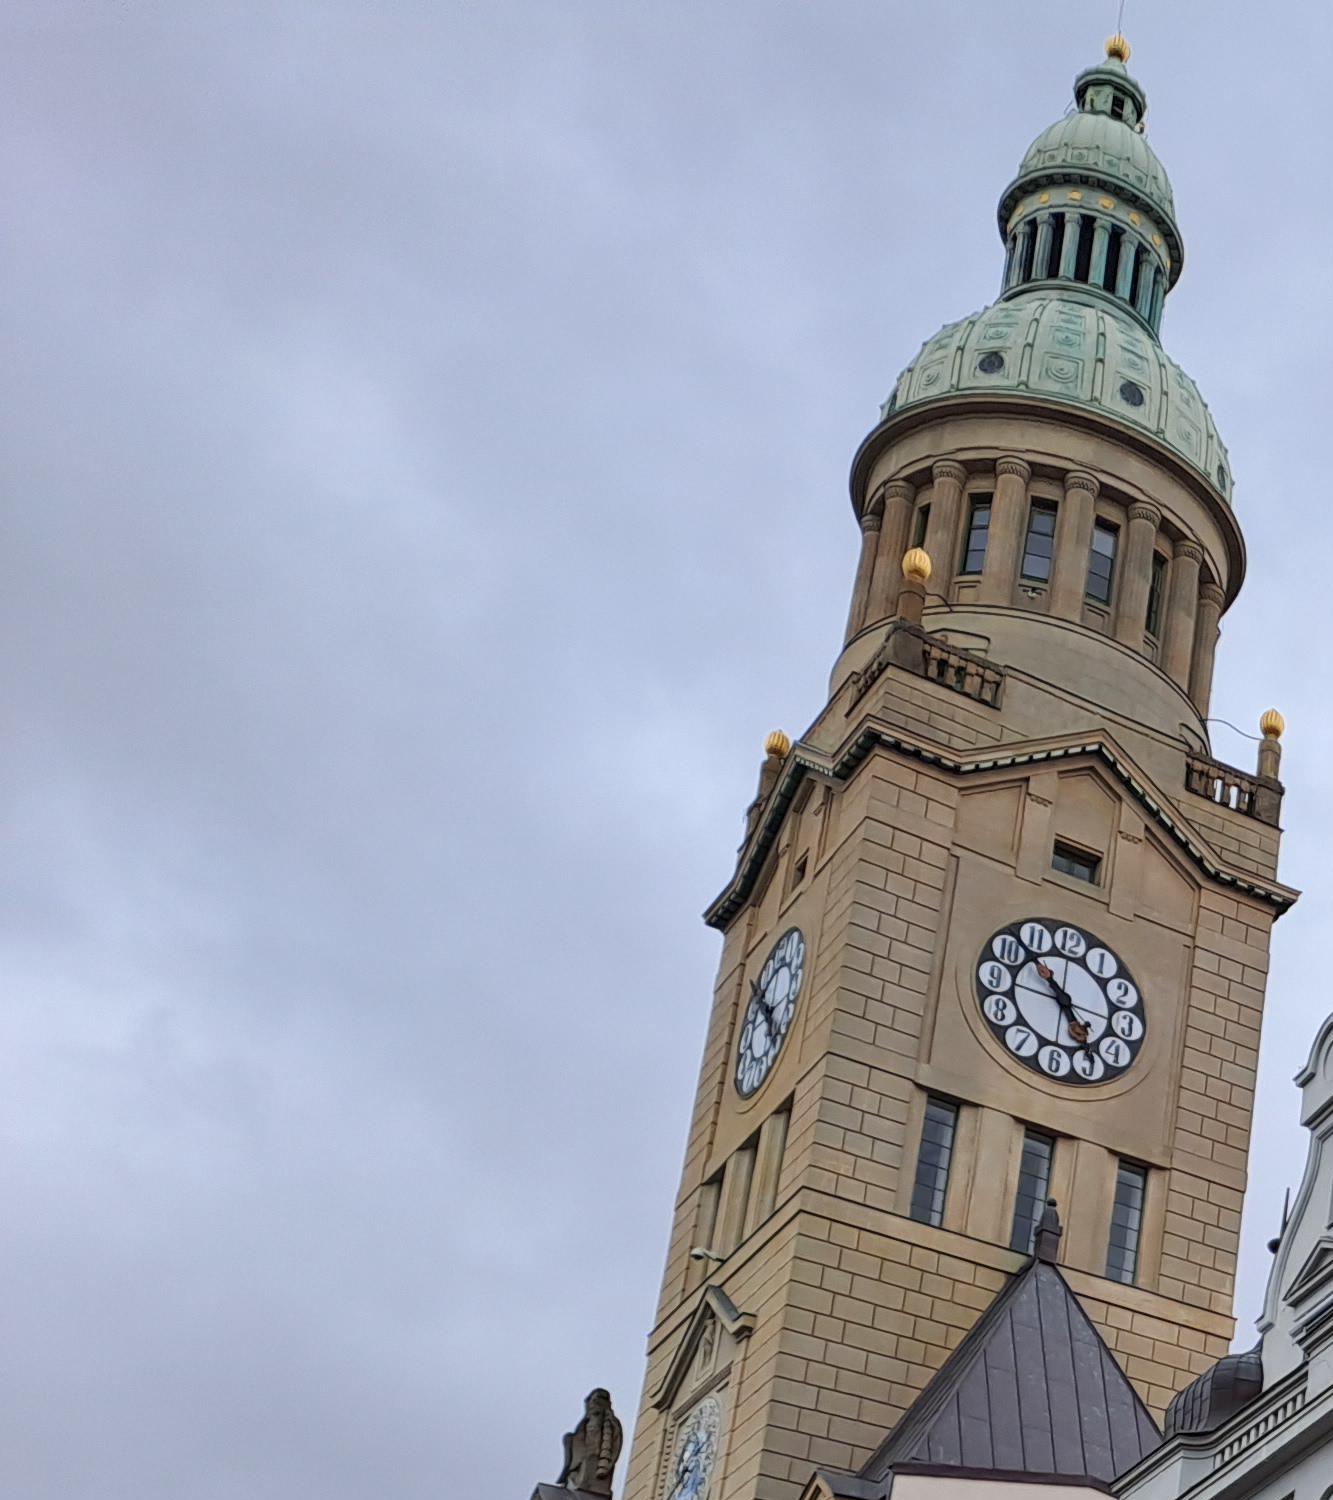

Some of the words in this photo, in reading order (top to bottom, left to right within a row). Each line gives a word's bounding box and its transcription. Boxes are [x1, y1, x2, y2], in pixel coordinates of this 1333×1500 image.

[1000, 937, 1020, 963] 10
[1028, 926, 1044, 951] 11
[1061, 930, 1081, 955] 12
[1097, 953, 1105, 974] 1
[988, 965, 1002, 988] 9
[1117, 982, 1129, 1005] 2
[993, 998, 1007, 1021] 8
[1121, 1014, 1134, 1037] 3
[1015, 1029, 1031, 1052] 7
[1105, 1040, 1121, 1064] 4
[1048, 1050, 1061, 1073] 6
